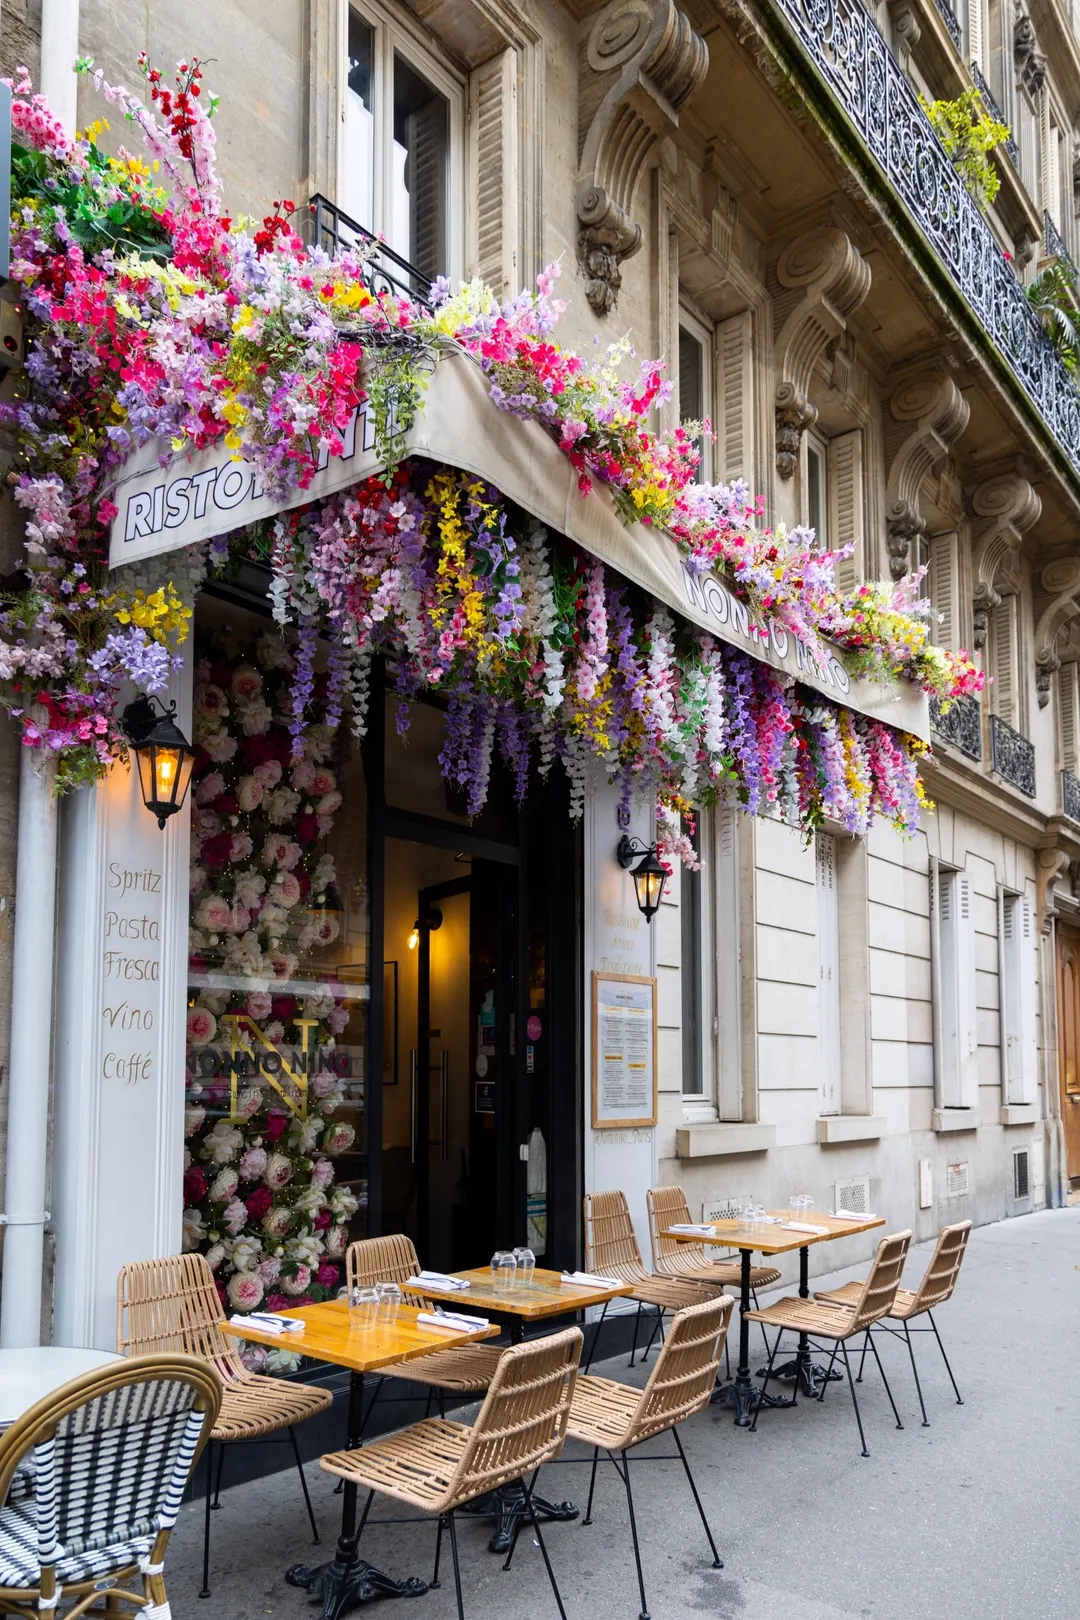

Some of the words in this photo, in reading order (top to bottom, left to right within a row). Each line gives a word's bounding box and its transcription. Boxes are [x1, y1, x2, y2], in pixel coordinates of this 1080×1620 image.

[108, 862, 162, 899] Spritz
[104, 911, 160, 941] Pasta
[104, 951, 160, 981] Fresca
[103, 1001, 153, 1030] Vino
[291, 1051, 351, 1075] NINO
